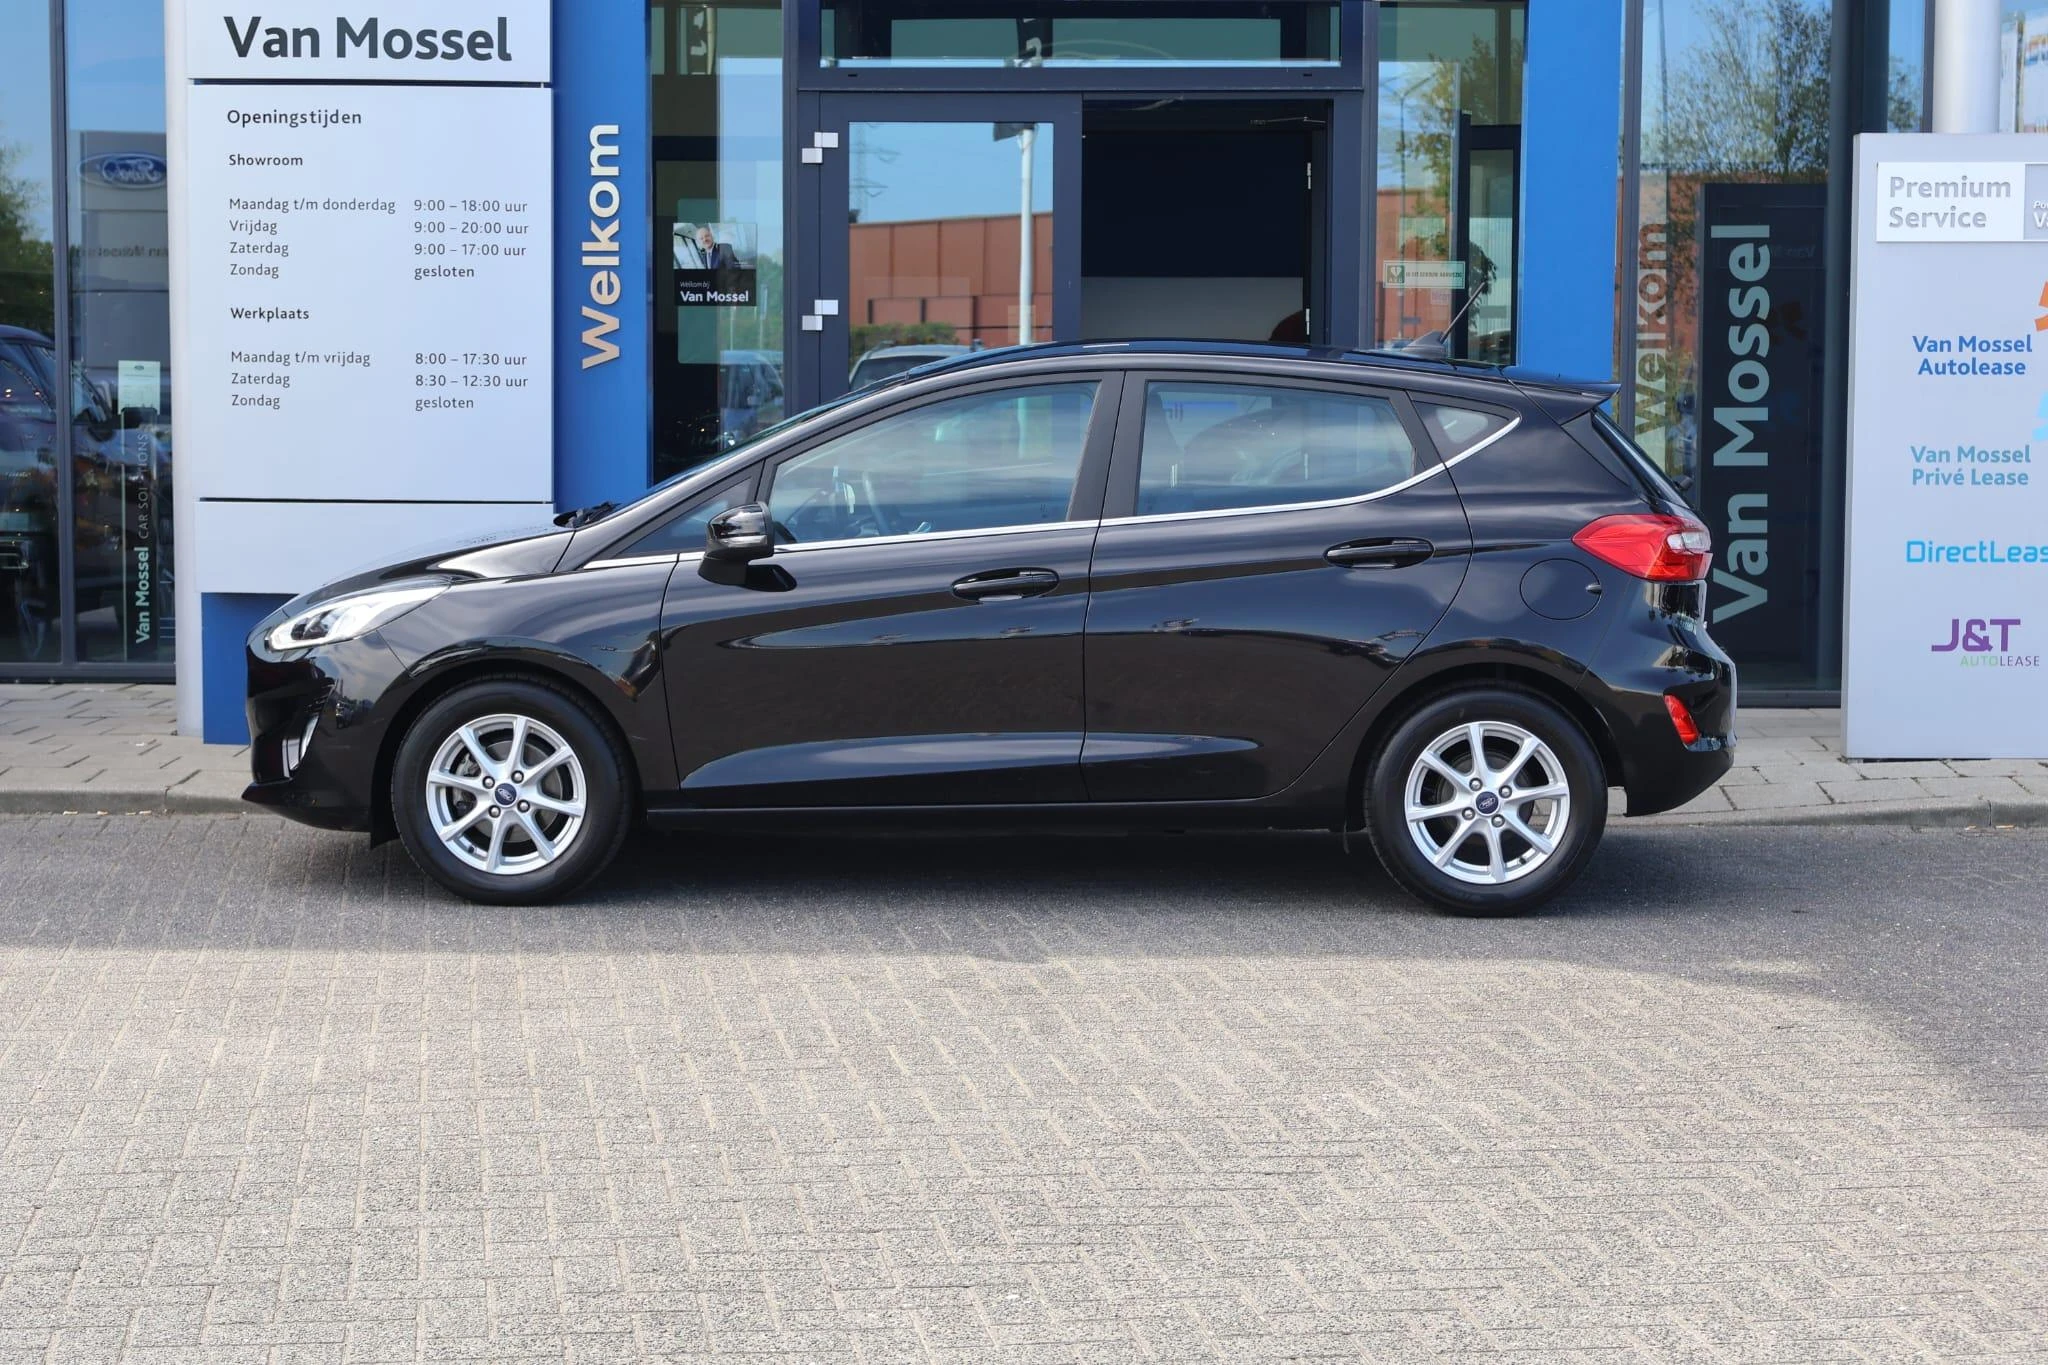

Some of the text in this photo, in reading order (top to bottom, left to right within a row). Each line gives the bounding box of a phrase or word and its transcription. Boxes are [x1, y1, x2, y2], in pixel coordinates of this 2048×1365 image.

[223, 16, 512, 61] Van Mossel
[227, 108, 361, 129] Openingstijden
[229, 153, 303, 167] Showroom
[1890, 175, 2011, 198] Premium
[229, 197, 289, 214] Maandag
[293, 197, 319, 211] t/m
[323, 197, 396, 215] donderdag
[414, 199, 446, 212] 9:00
[461, 199, 500, 213] 18:00
[504, 203, 528, 213] uur
[1889, 205, 1987, 228] Service
[229, 219, 278, 236] Vrijdag
[414, 221, 446, 234] 9:00
[461, 221, 502, 235] 20:00
[506, 225, 529, 235] uur
[229, 241, 289, 258] Zaterdag
[414, 243, 446, 256] 9:00
[461, 243, 500, 257] 17:00
[504, 247, 527, 257] uur
[581, 124, 621, 369] Welkom
[230, 263, 475, 281] Zondag gesloten
[680, 290, 749, 303] Van Mossel
[230, 306, 310, 323] Werkplaats
[1635, 223, 1667, 436] Welkom
[1912, 334, 2033, 353] Van Mossel
[231, 350, 291, 367] Maandag
[295, 350, 320, 364] t/m
[324, 351, 371, 368] vrijdag
[415, 352, 447, 366] 8:00
[462, 352, 500, 366] 17:30
[504, 356, 528, 366] uur
[1918, 357, 2026, 376] Autolease
[231, 372, 291, 389] Zaterdag
[415, 374, 447, 387] 8:30
[462, 374, 501, 388] 12:30
[505, 378, 529, 388] uur
[231, 394, 474, 412] Zondag gesloten
[1711, 225, 1771, 624] Van Mossel
[1910, 444, 2032, 463] Van Mossel
[1912, 467, 2029, 486] Privé Lease
[138, 514, 149, 539] CAR
[133, 546, 149, 607] Mossel
[136, 611, 150, 645] Van
[1931, 618, 2021, 652] J&T
[1960, 655, 2040, 667] AUTOLEASE
